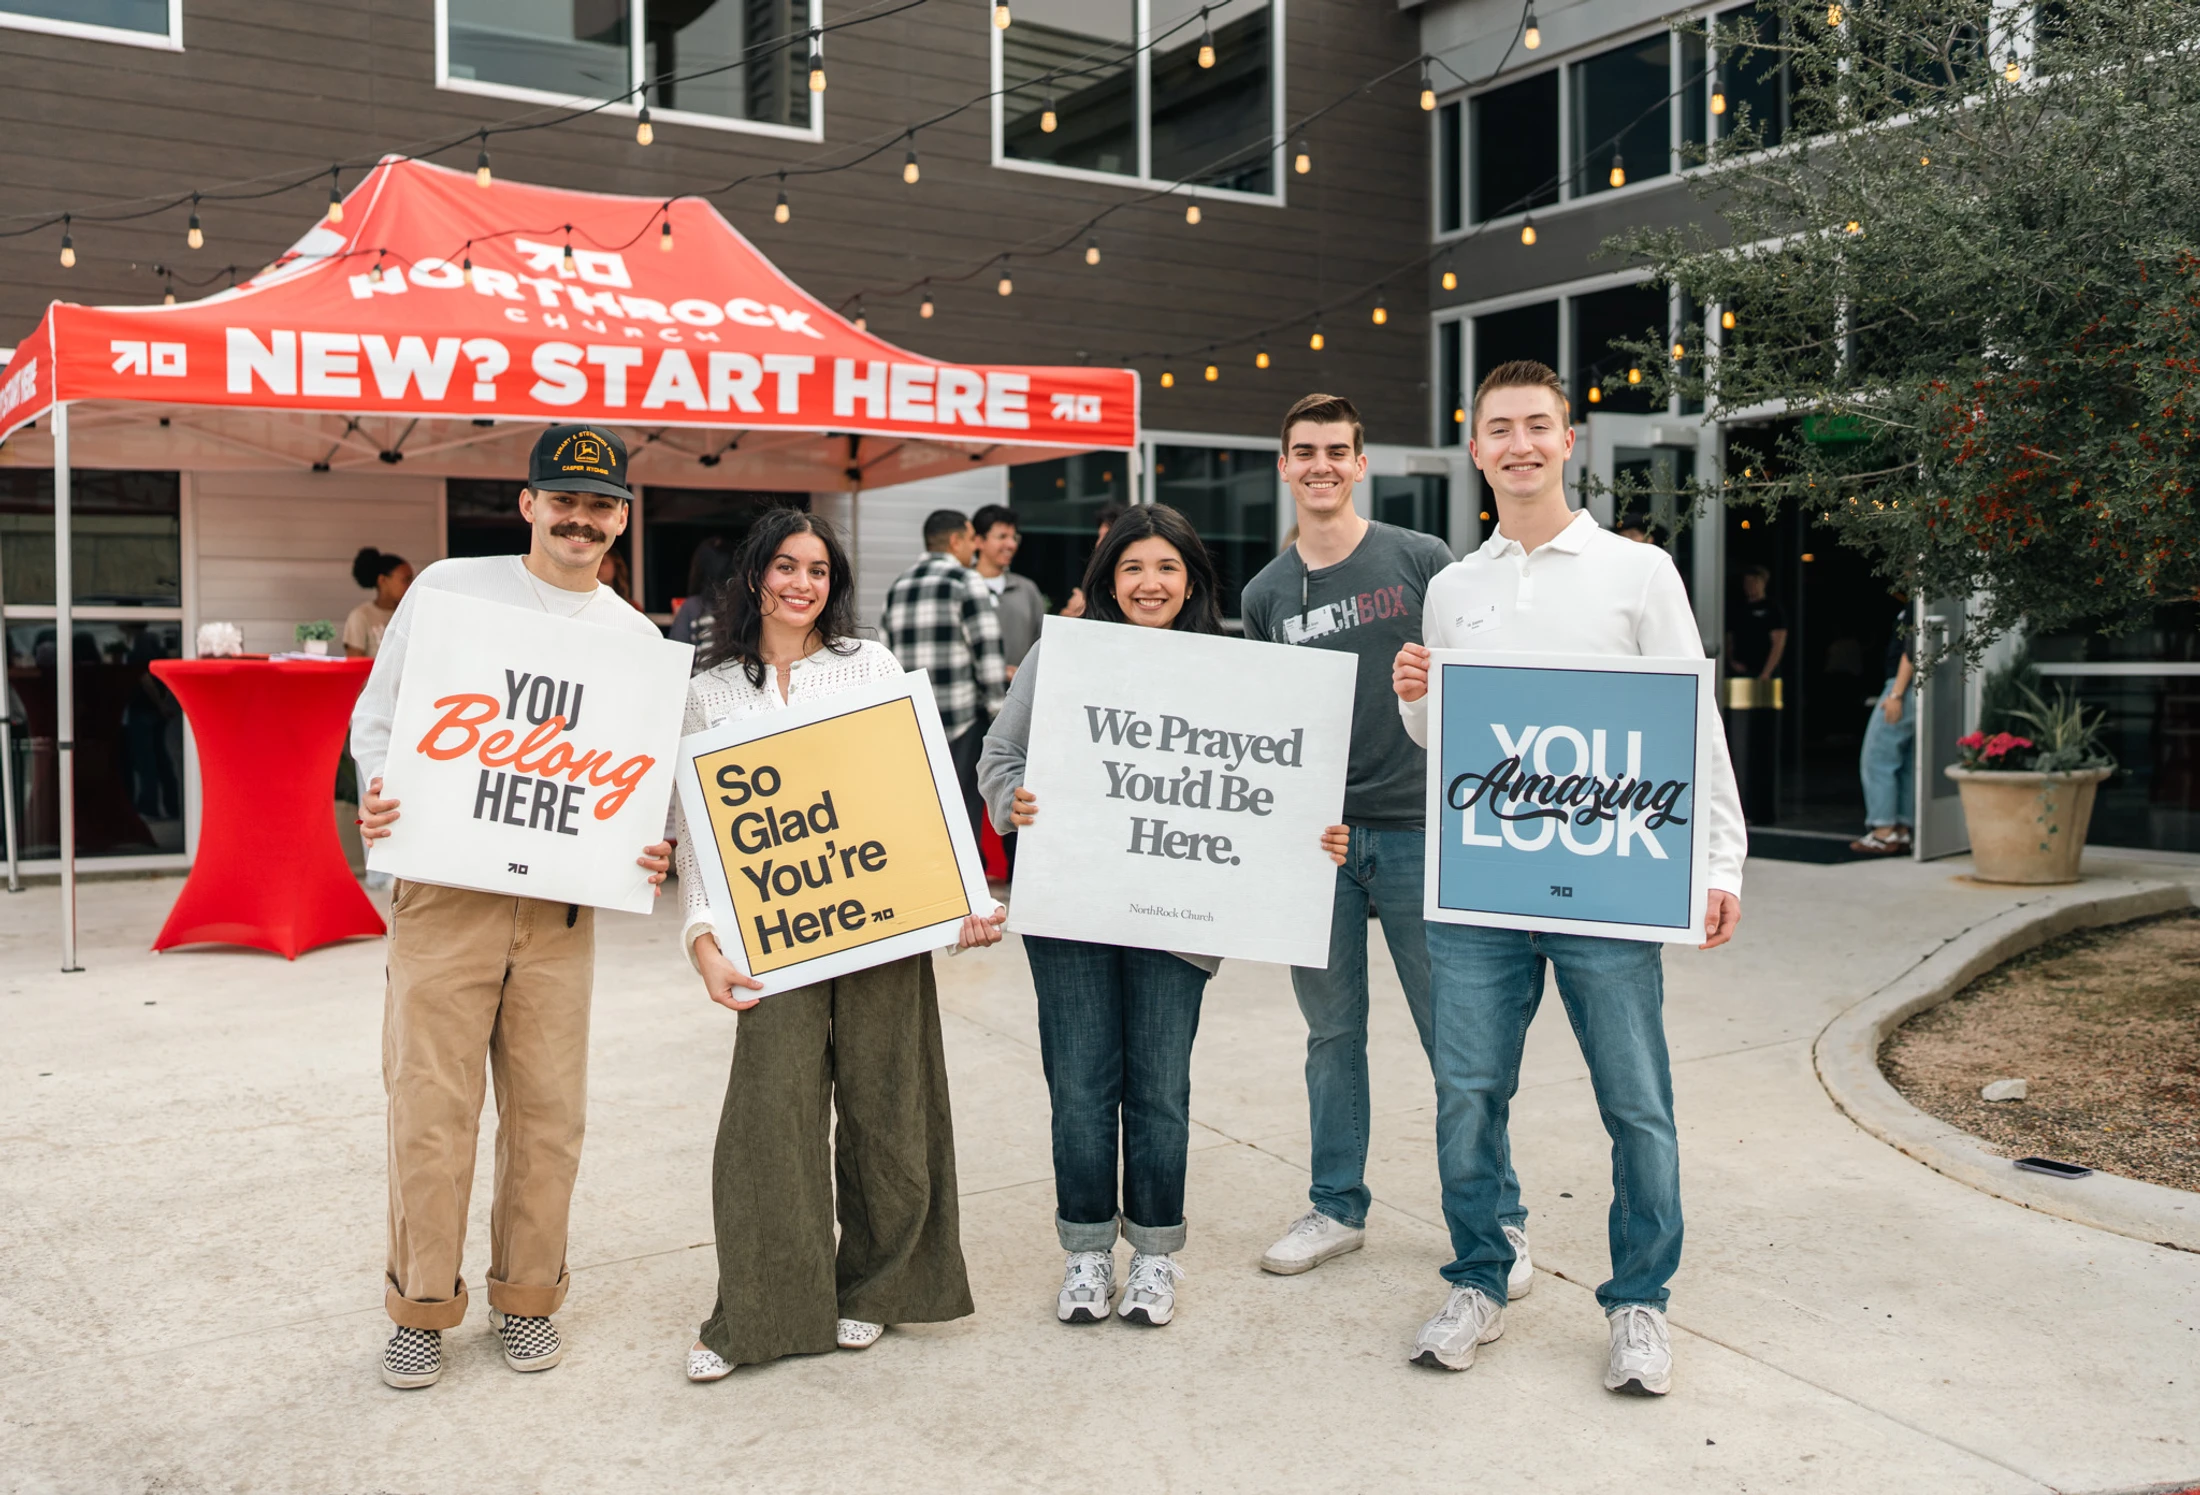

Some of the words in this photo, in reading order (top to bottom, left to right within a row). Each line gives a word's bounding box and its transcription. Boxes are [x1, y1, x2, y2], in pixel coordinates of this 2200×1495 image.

[348, 257, 826, 339] NORTHROCK
[504, 307, 722, 343] CHURCH
[225, 326, 511, 402] NEW?
[529, 340, 815, 414] START
[833, 357, 1031, 430] HERE
[505, 668, 584, 732] YOU
[416, 693, 656, 820] Belong
[1083, 705, 1152, 749] We
[1156, 714, 1304, 772] Prayed
[1489, 723, 1642, 790] YOU
[473, 769, 586, 836] HERE
[716, 764, 781, 807] So
[1102, 760, 1212, 809] You'd
[1216, 774, 1274, 816] Be
[1447, 754, 1689, 830] Amazing
[730, 790, 840, 855] Glad
[1126, 816, 1241, 866] Here.
[1462, 787, 1669, 860] LOOK
[740, 840, 888, 903] You're
[754, 899, 867, 955] Here
[1129, 903, 1179, 918] NorthRock
[1181, 909, 1214, 922] Church
